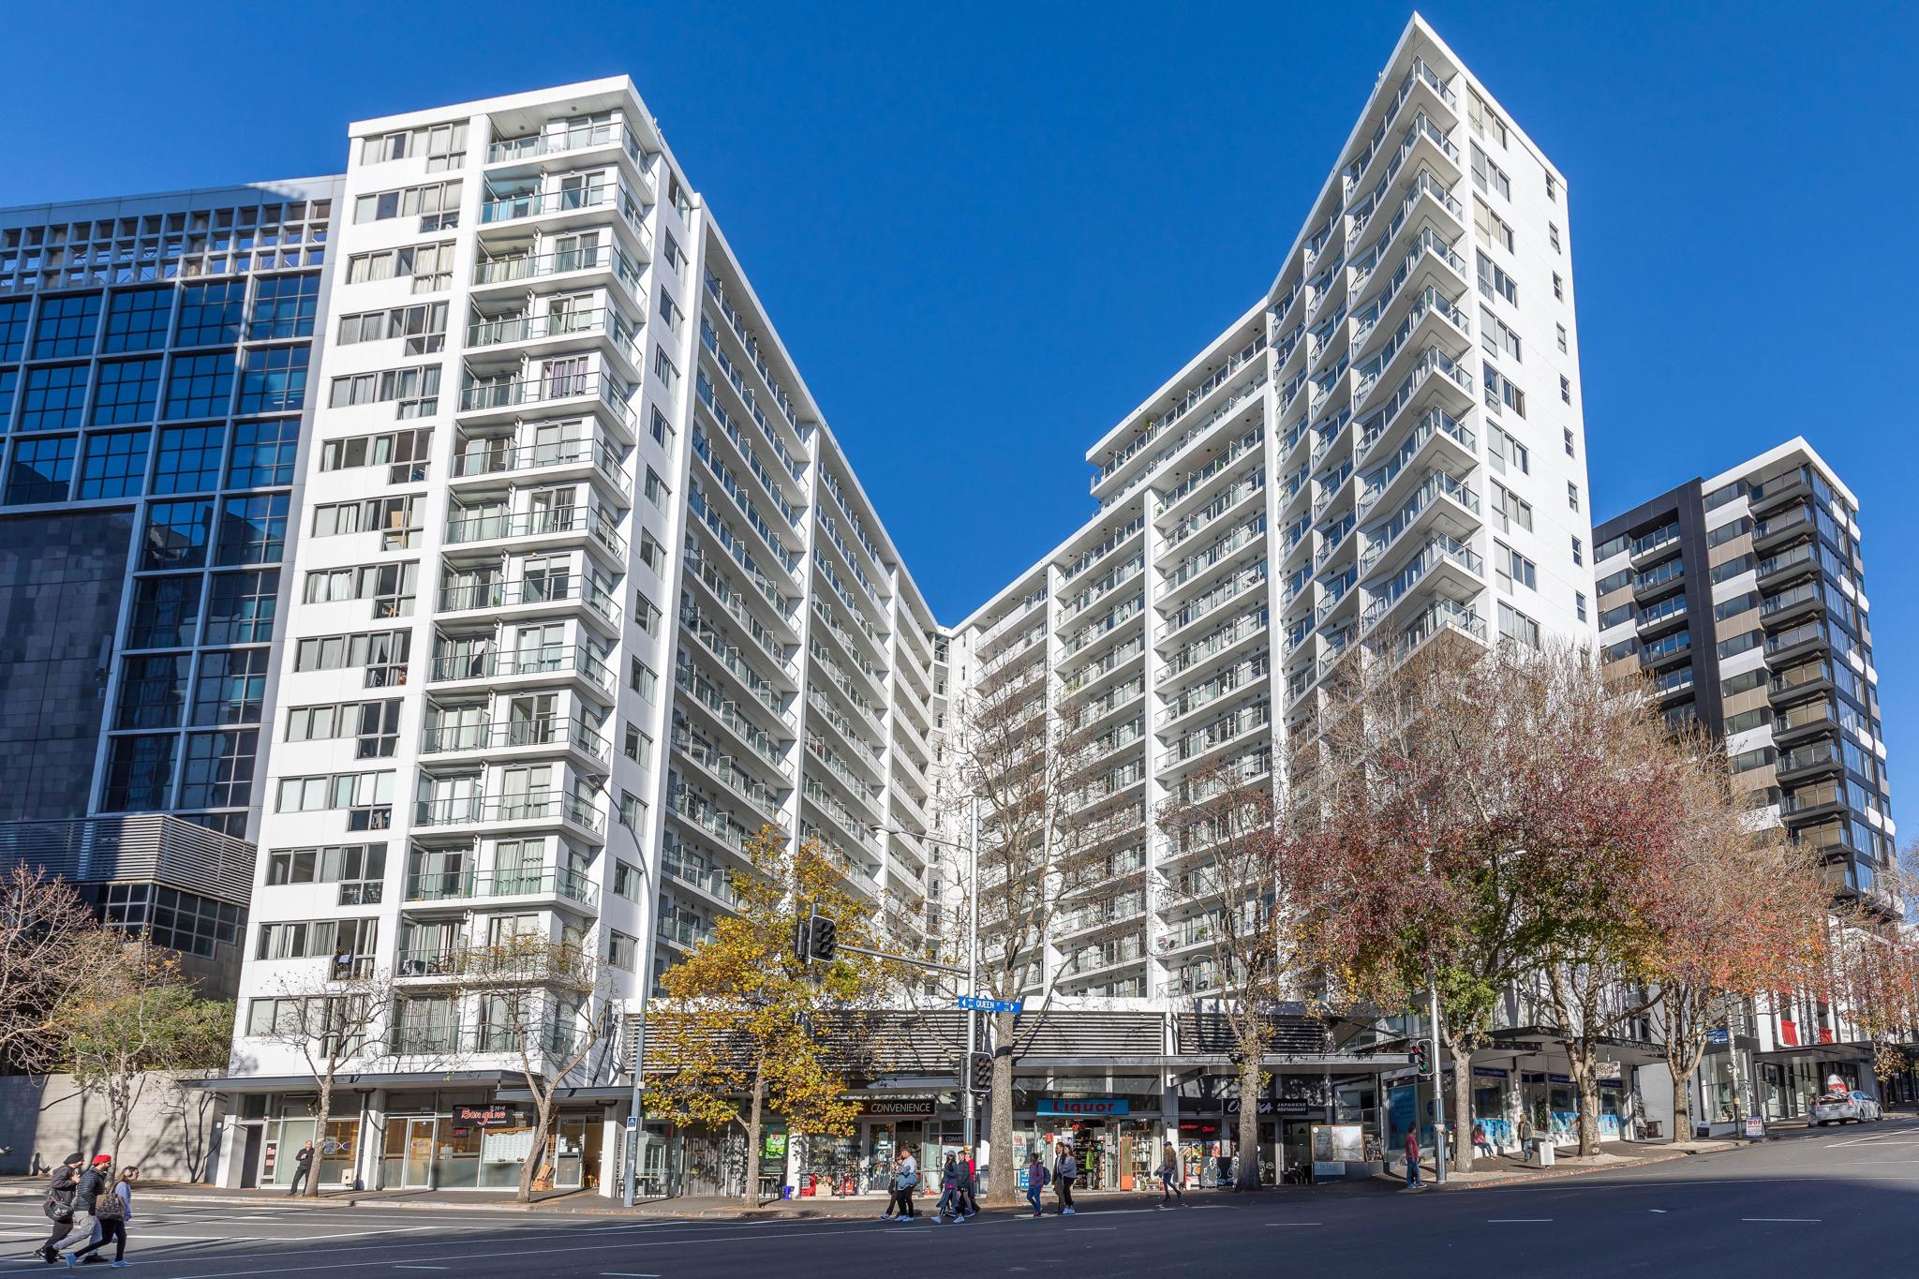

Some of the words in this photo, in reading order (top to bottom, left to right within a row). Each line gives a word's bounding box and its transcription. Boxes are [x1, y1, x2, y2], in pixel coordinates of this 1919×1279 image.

[975, 1000, 995, 1009] QUEEN
[870, 1103, 931, 1113] CONVENIENCE
[1053, 1099, 1114, 1114] Liquor
